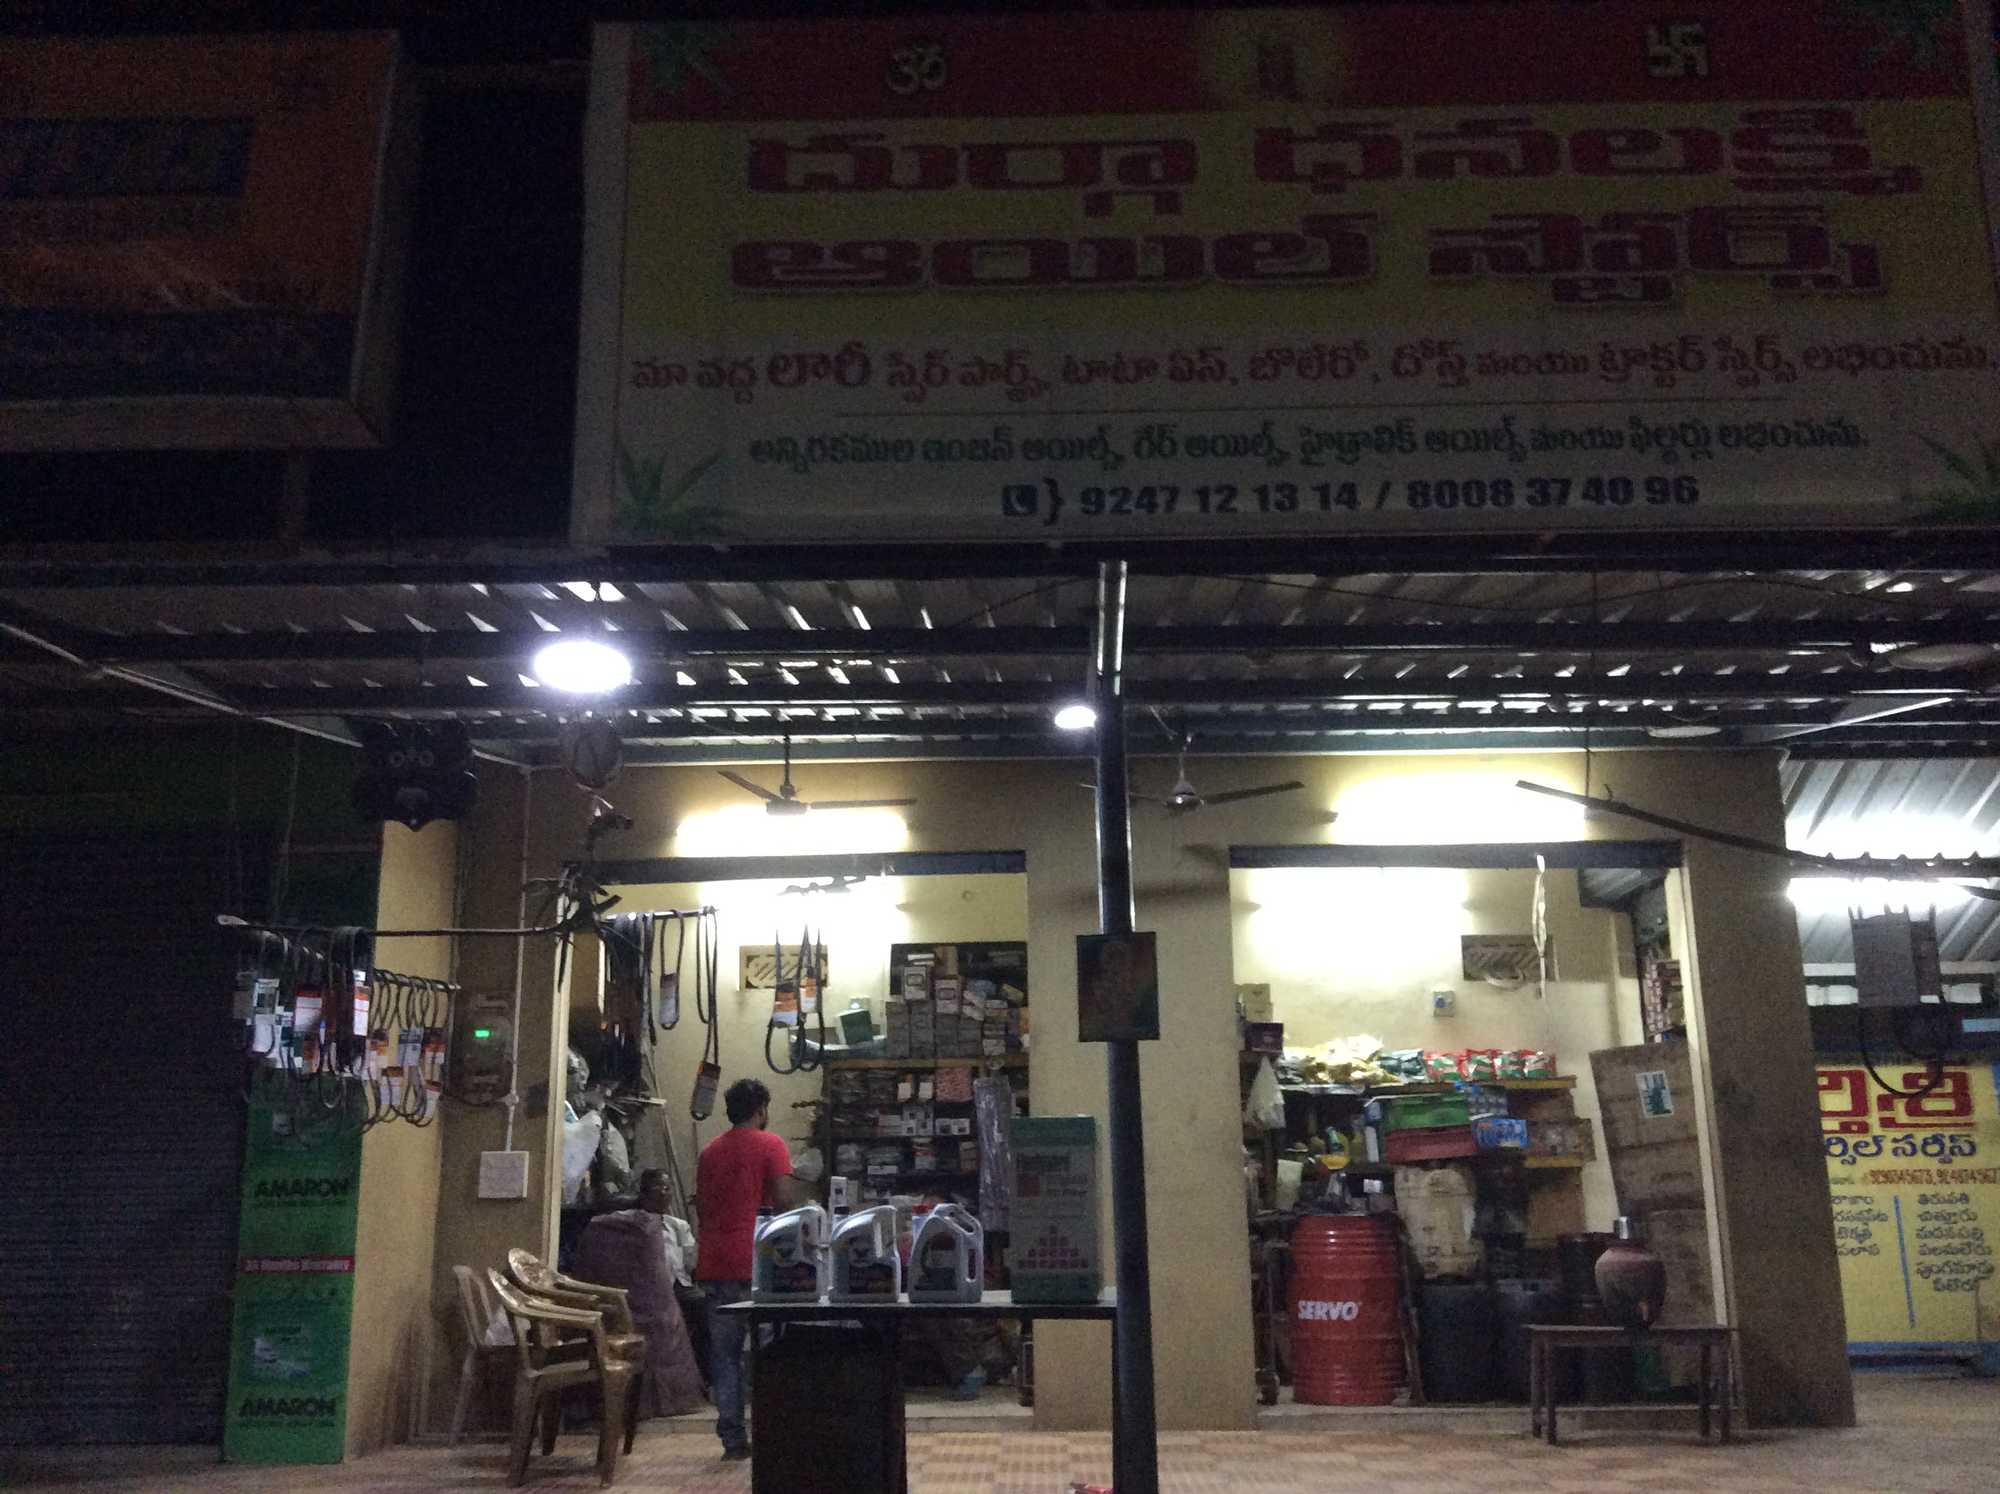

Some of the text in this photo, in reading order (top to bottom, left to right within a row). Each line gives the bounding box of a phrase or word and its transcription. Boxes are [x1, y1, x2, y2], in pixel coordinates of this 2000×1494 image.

[749, 108, 1924, 217] దుర్గా ధనలక్ష్మి
[731, 212, 1378, 290] ఆయిల్
[632, 356, 688, 389] మా
[696, 357, 757, 404] వద్ద
[767, 341, 872, 388] లారీ
[1063, 354, 1157, 386] టాటా
[1391, 336, 1469, 388] దోస్త్
[1478, 350, 1589, 378] మరియు
[1598, 335, 1705, 388] ట్రాక్టర్
[1134, 422, 1179, 460] గేర్
[1078, 486, 1176, 517] 9247
[1194, 486, 1238, 515] 12
[1255, 484, 1299, 514] 13
[1311, 483, 1361, 513] 14
[1407, 479, 1514, 510] 8008
[1526, 478, 1572, 508] 37
[1581, 477, 1635, 508] 40
[1644, 476, 1699, 506] 96
[1890, 1133, 1978, 1164] సర్వీస్
[254, 1177, 350, 1198] AMARON
[1296, 1300, 1360, 1321] SERVO
[239, 1396, 338, 1418] AMARON
